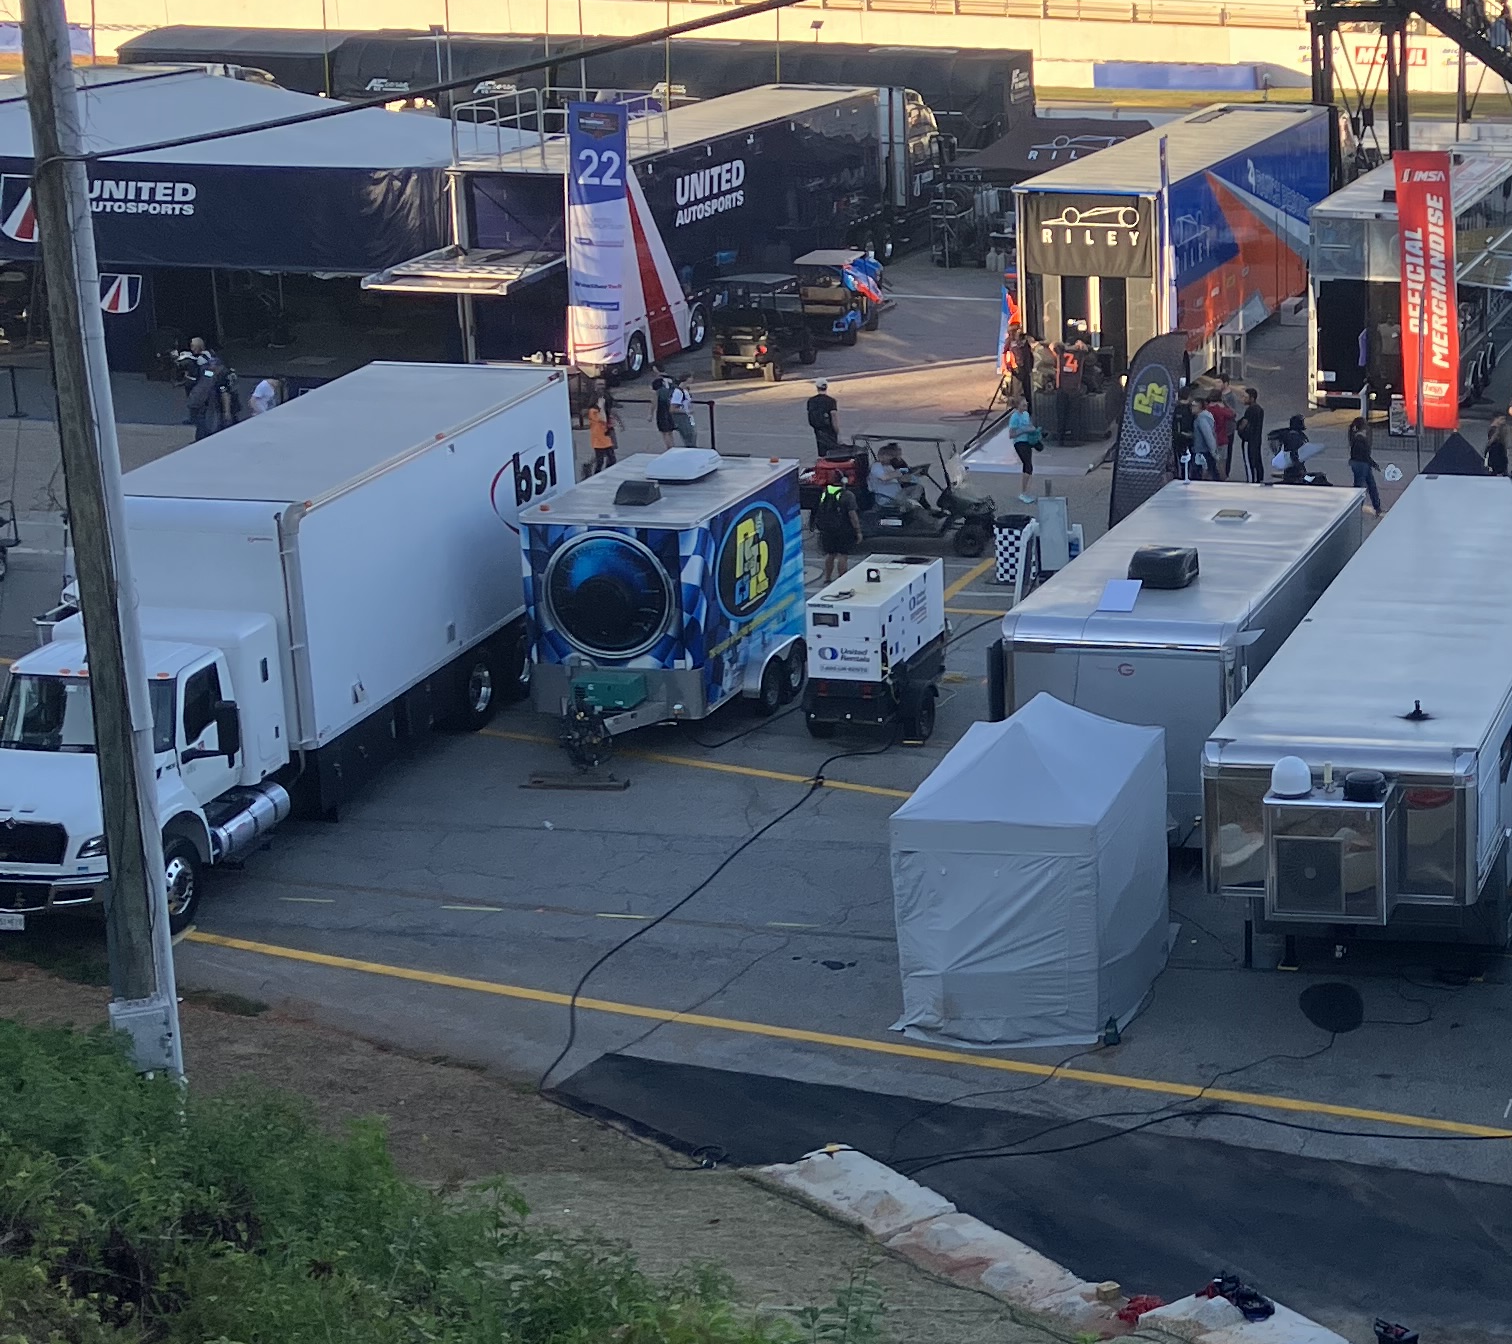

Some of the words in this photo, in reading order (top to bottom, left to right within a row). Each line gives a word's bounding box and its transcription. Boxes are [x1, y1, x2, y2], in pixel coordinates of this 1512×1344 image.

[1357, 52, 1425, 65] MOUL
[578, 148, 622, 186] 22
[676, 159, 745, 206] UNITED
[1413, 170, 1446, 183] IMSA
[88, 180, 197, 202] UNITED
[675, 189, 745, 228] AUTOSPORTS
[1041, 228, 1140, 247] RILEY
[1404, 227, 1429, 336] OFFICIAL
[1426, 193, 1450, 369] MERCHANDISE
[512, 429, 558, 507] bsi
